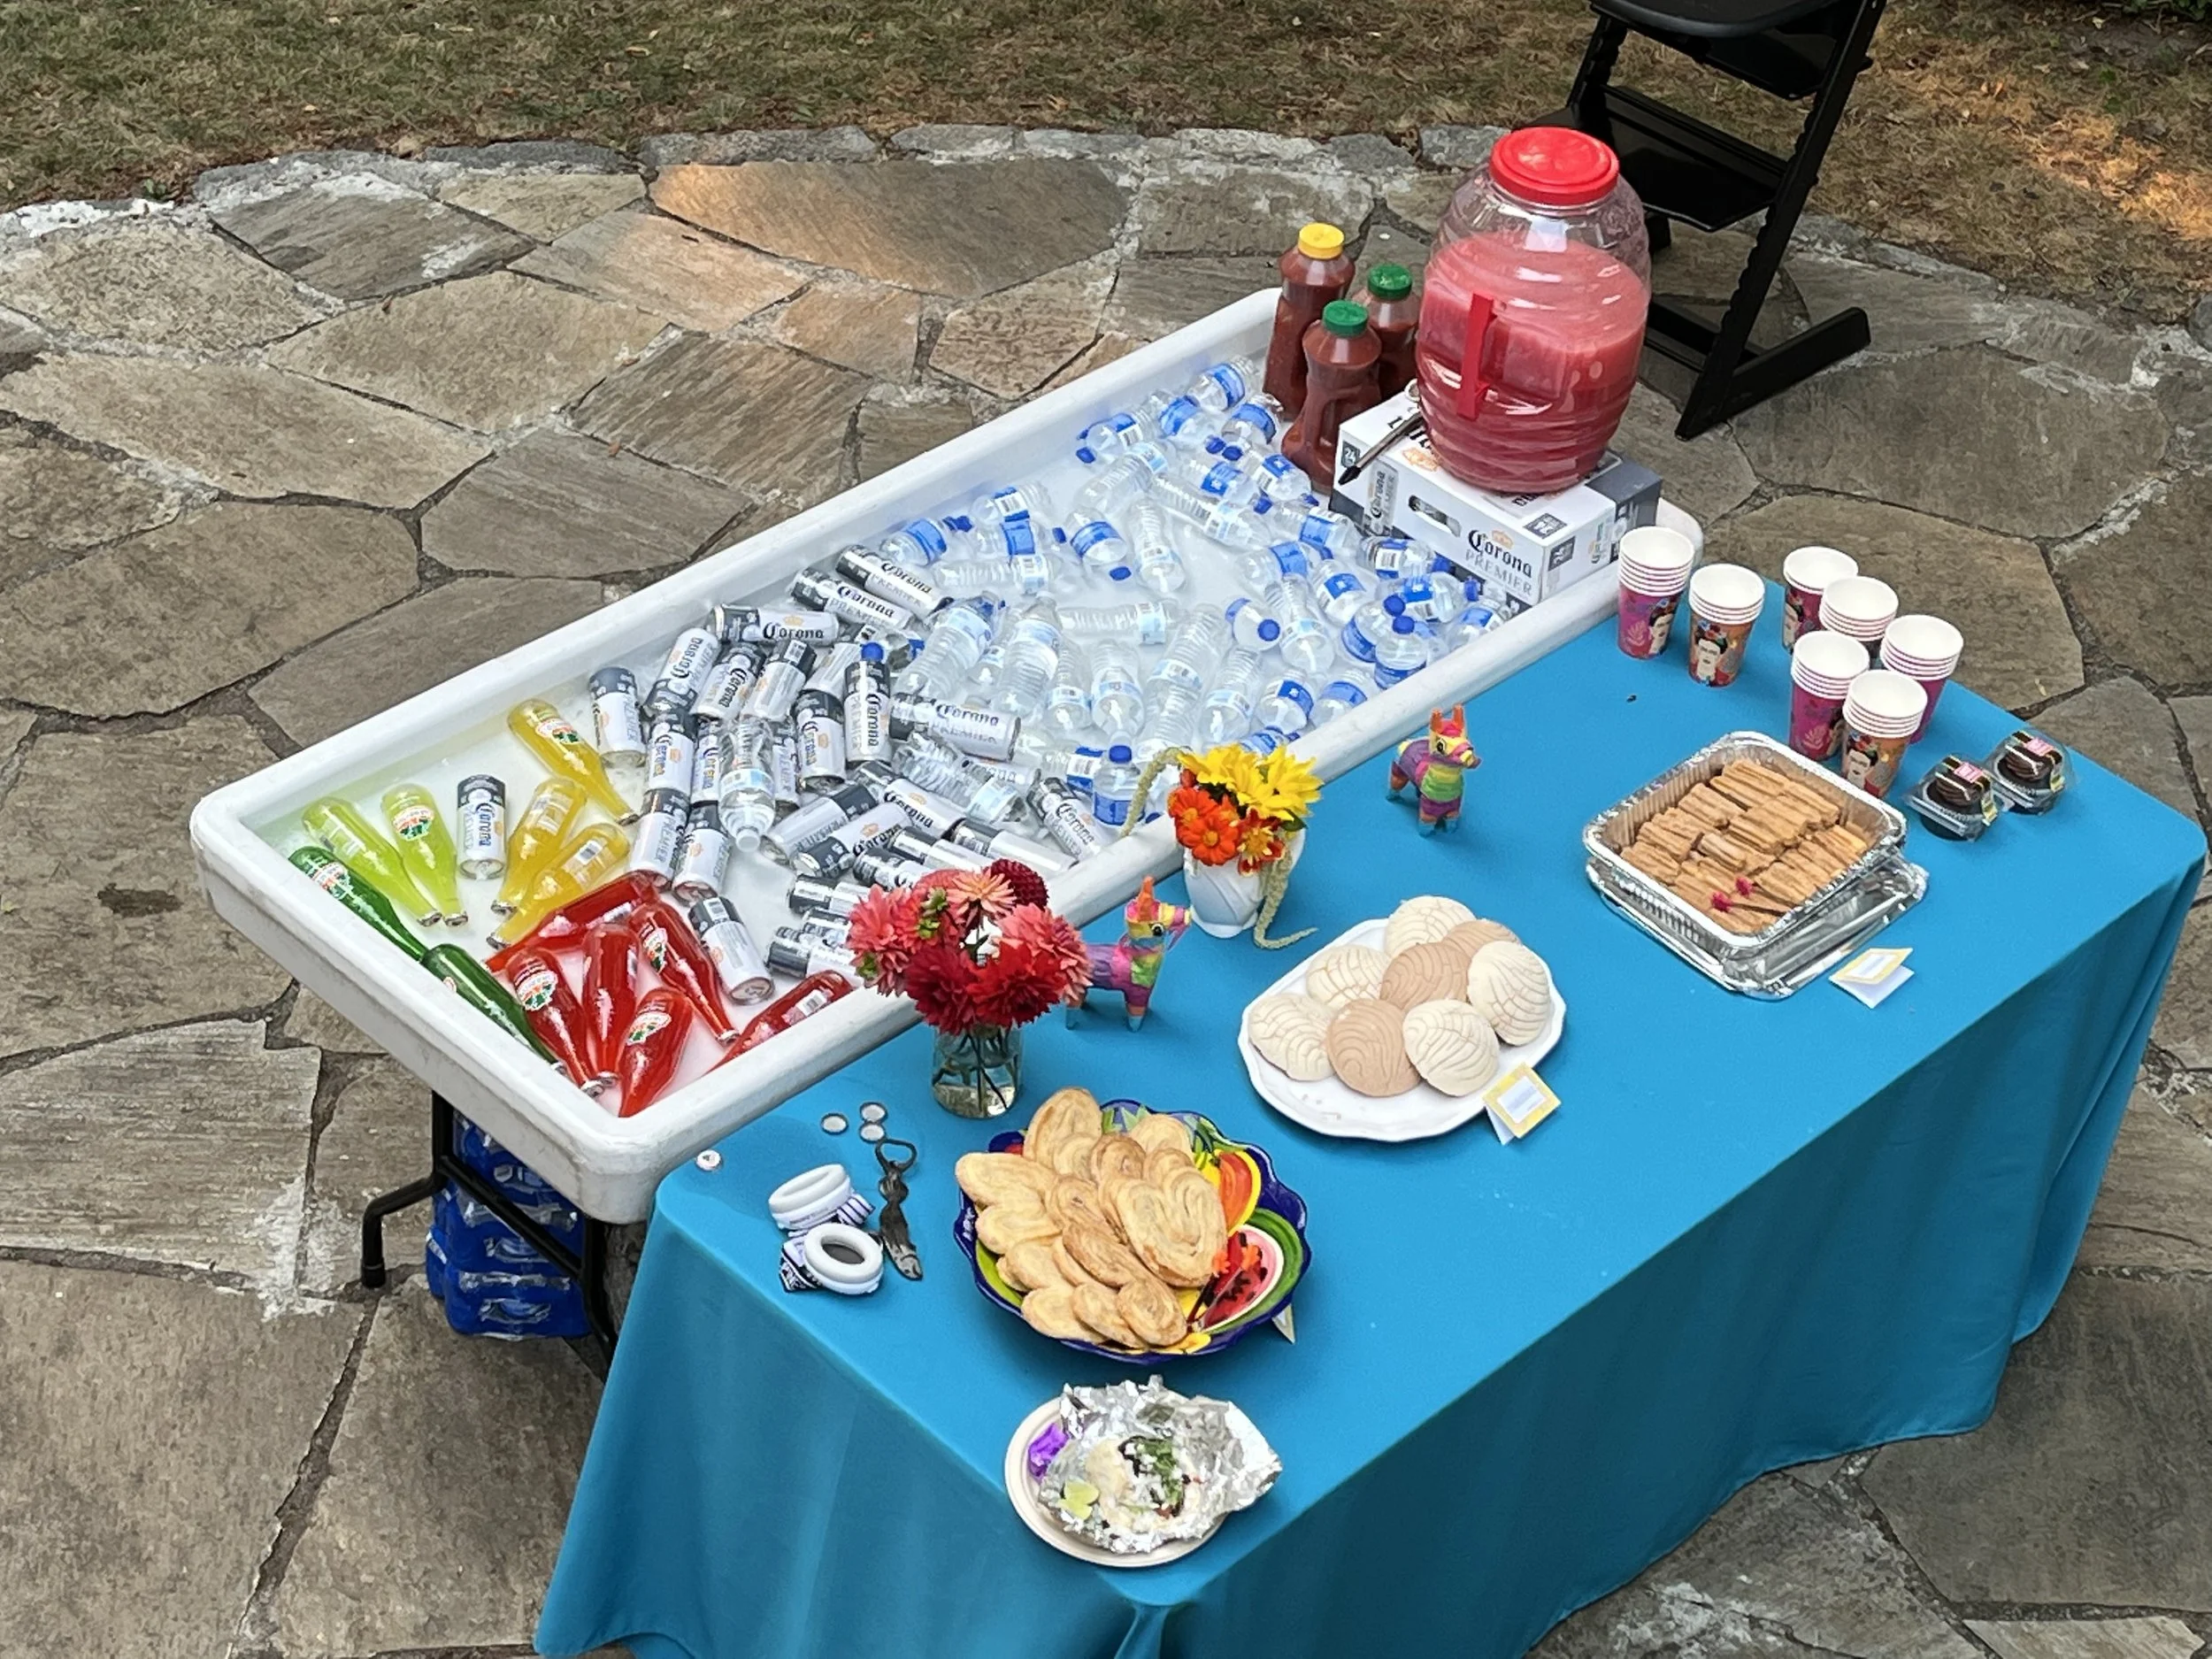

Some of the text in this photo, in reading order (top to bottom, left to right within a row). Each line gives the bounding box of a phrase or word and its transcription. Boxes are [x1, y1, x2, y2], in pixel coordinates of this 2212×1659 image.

[1465, 549, 1532, 596] PREMIER
[1468, 528, 1532, 580] Corona
[881, 562, 933, 594] Corona
[837, 586, 895, 618] Corona
[763, 622, 825, 641] Corona
[670, 636, 703, 680] Corona
[718, 667, 748, 708] Corona
[865, 694, 881, 747] Corona
[936, 703, 1000, 726] Corona
[475, 803, 495, 847] Corona
[655, 819, 676, 864] PREMIER
[1056, 803, 1095, 846] Corona
